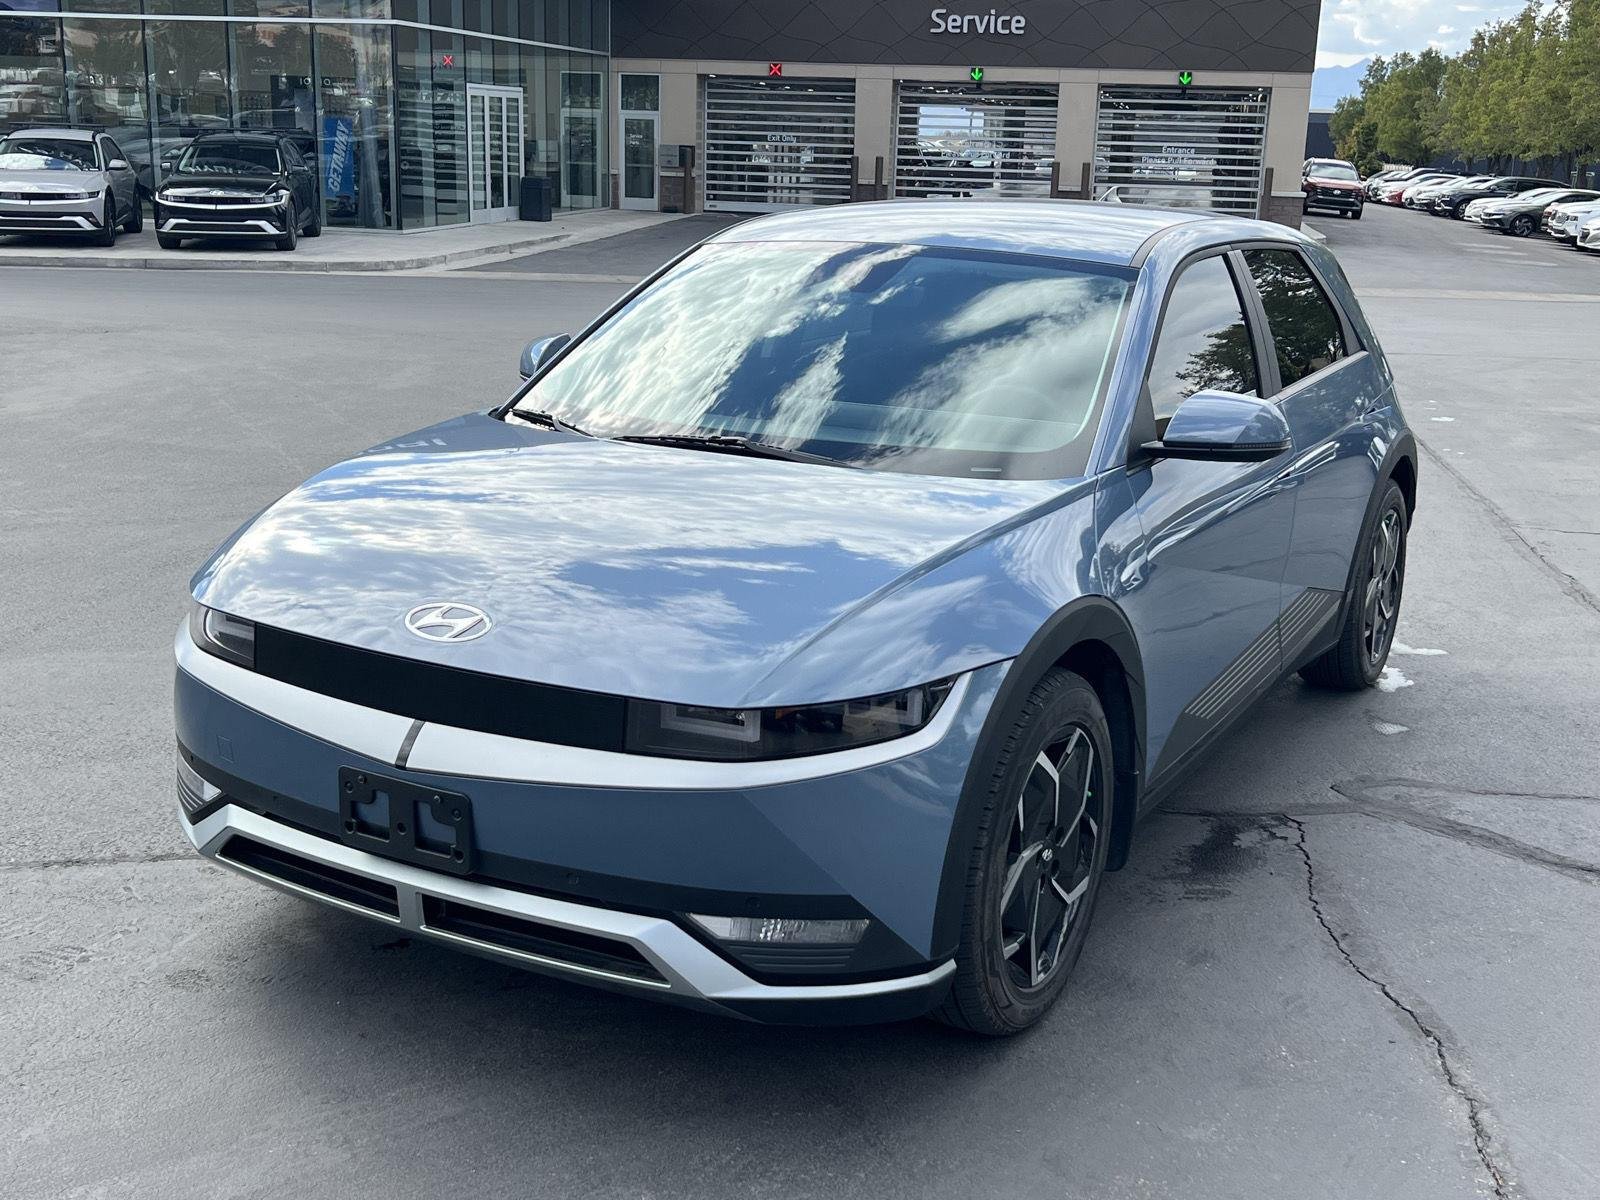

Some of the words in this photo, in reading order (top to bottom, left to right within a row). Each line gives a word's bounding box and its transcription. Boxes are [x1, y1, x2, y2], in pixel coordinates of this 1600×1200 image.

[929, 8, 1026, 35] Service
[767, 134, 781, 142] Exit
[782, 134, 797, 144] Only
[1161, 145, 1196, 154] Entrance
[327, 119, 349, 193] GETAWAY
[1141, 156, 1165, 164] Please
[1183, 157, 1217, 165] Forward
